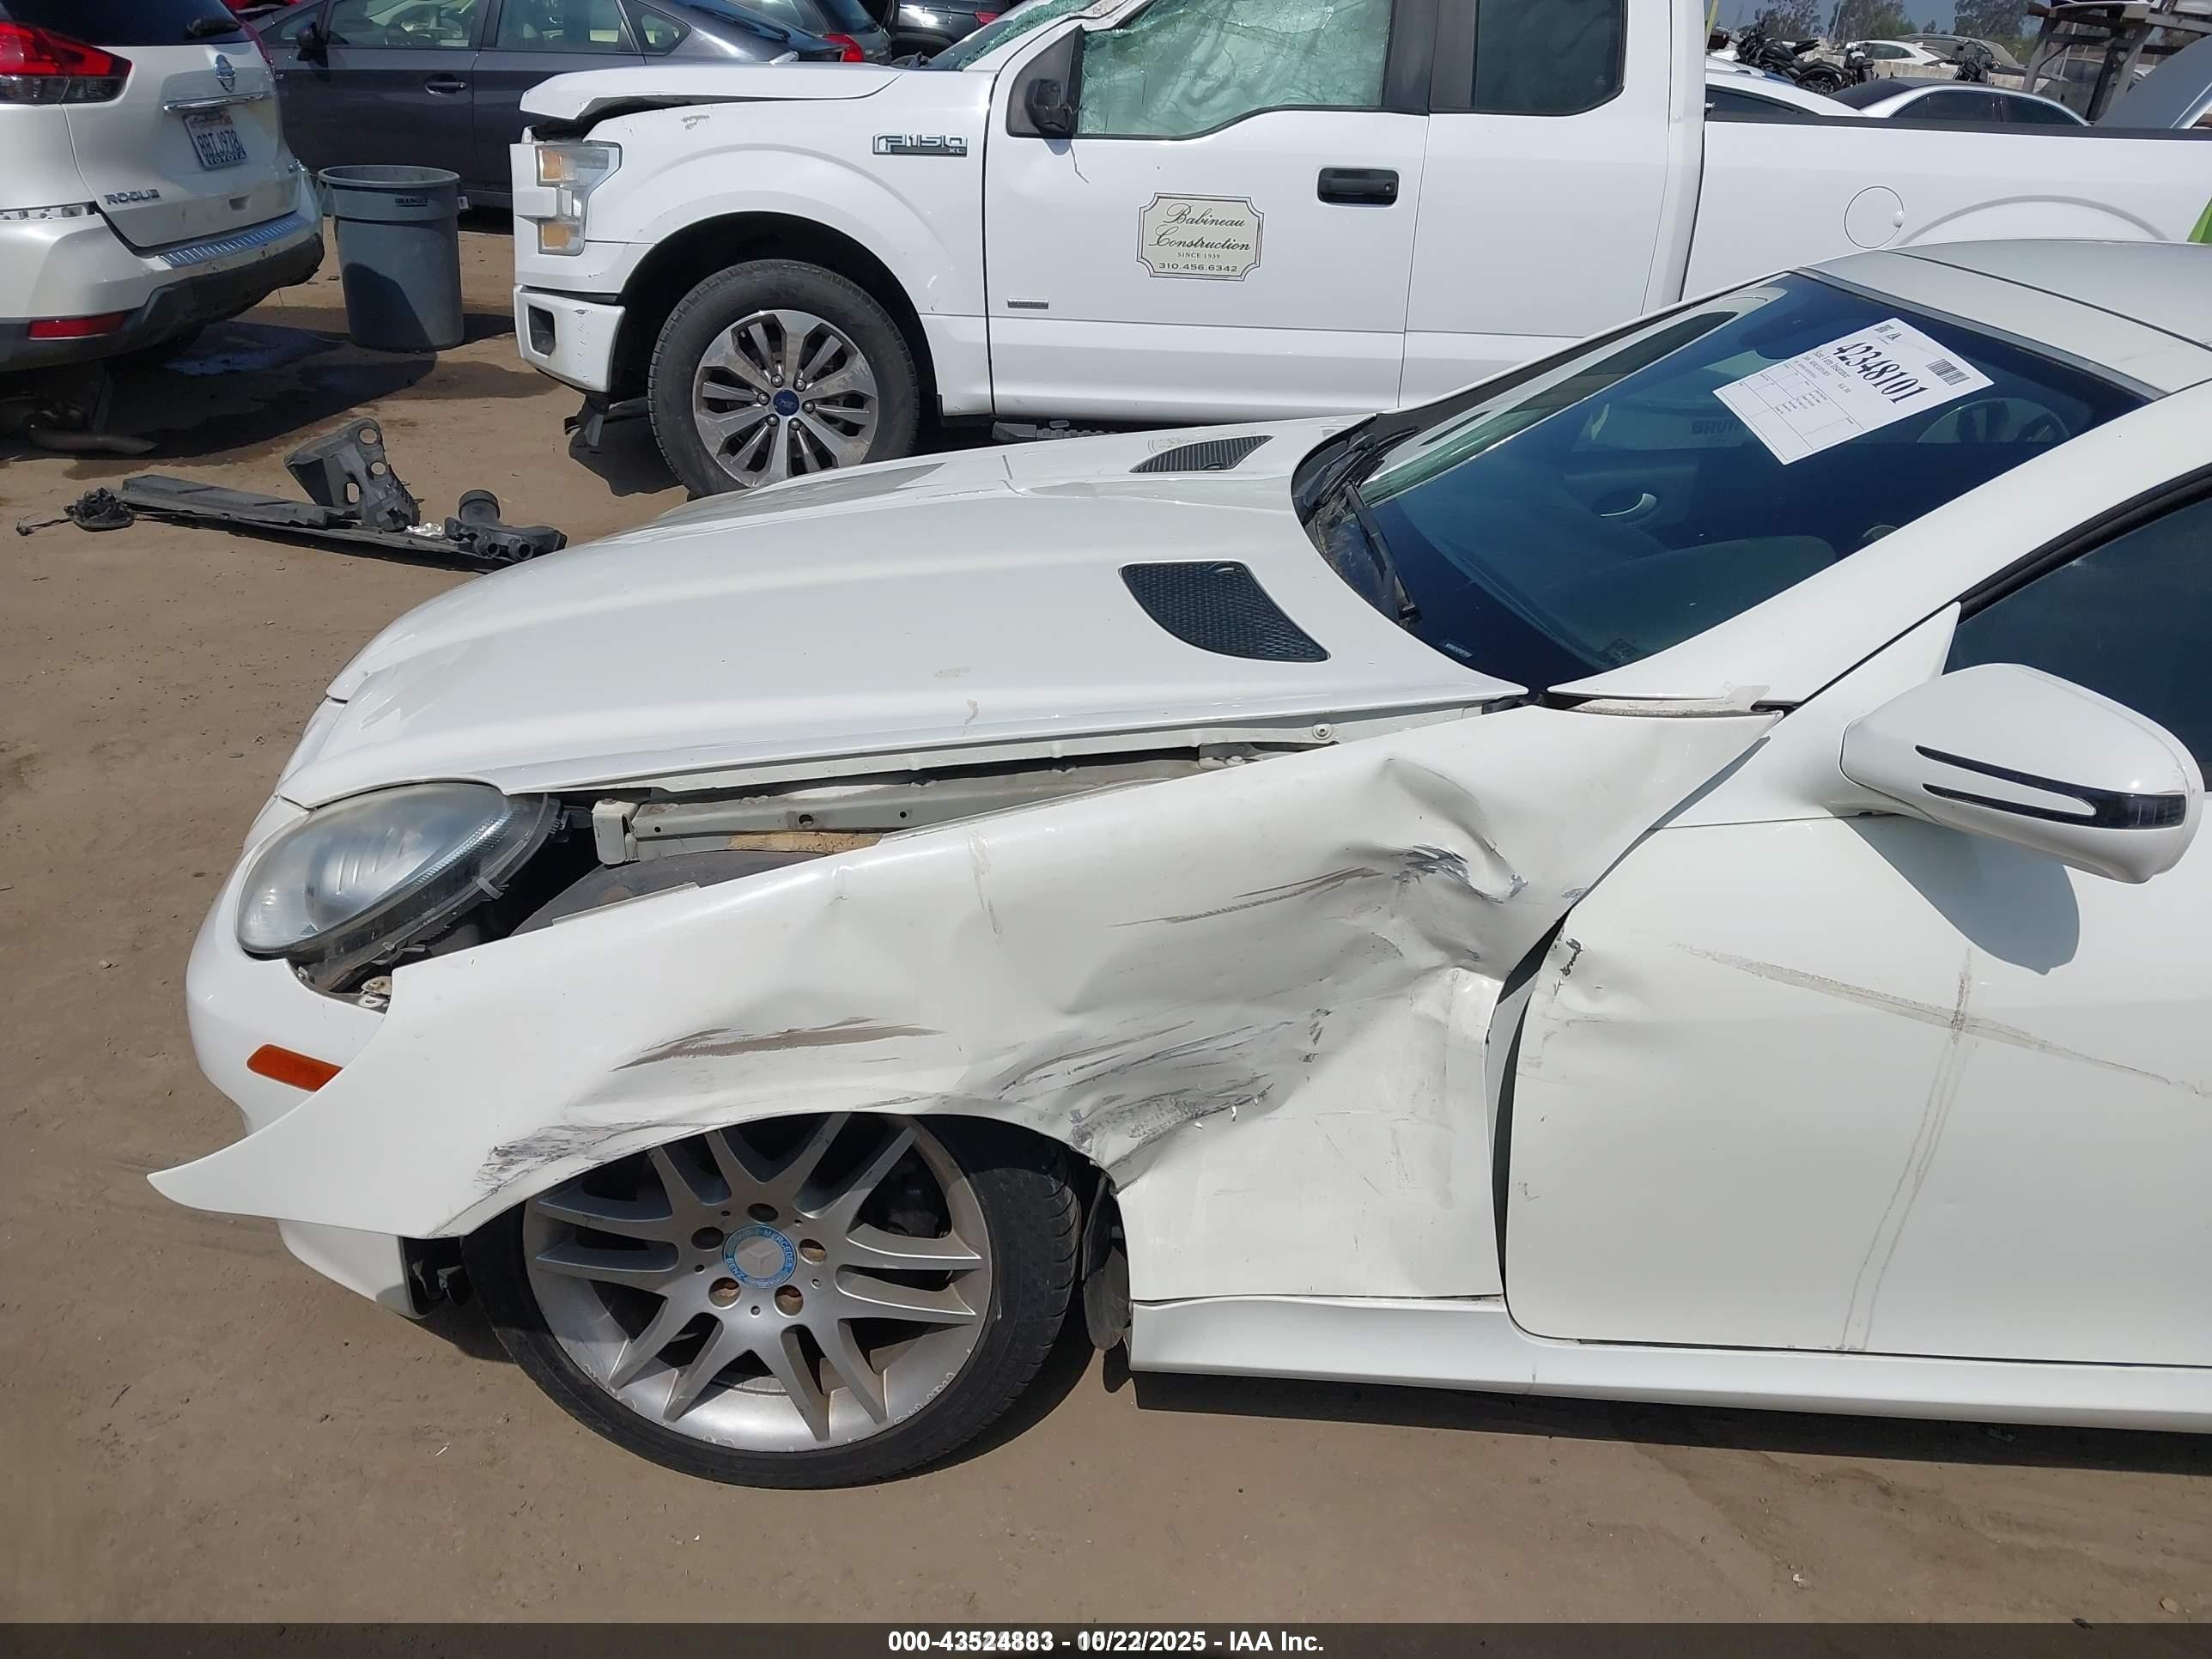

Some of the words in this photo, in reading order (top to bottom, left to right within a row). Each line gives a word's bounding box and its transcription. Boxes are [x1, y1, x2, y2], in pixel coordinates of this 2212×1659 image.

[207, 150, 246, 166] TOYOTA
[104, 189, 161, 205] ROGUE
[1163, 203, 1246, 228] Babineau
[1148, 224, 1251, 251] Construction
[1158, 262, 1238, 272] 310.456.6342
[1832, 341, 1929, 404] 42348101
[726, 1257, 748, 1282] BENZ
